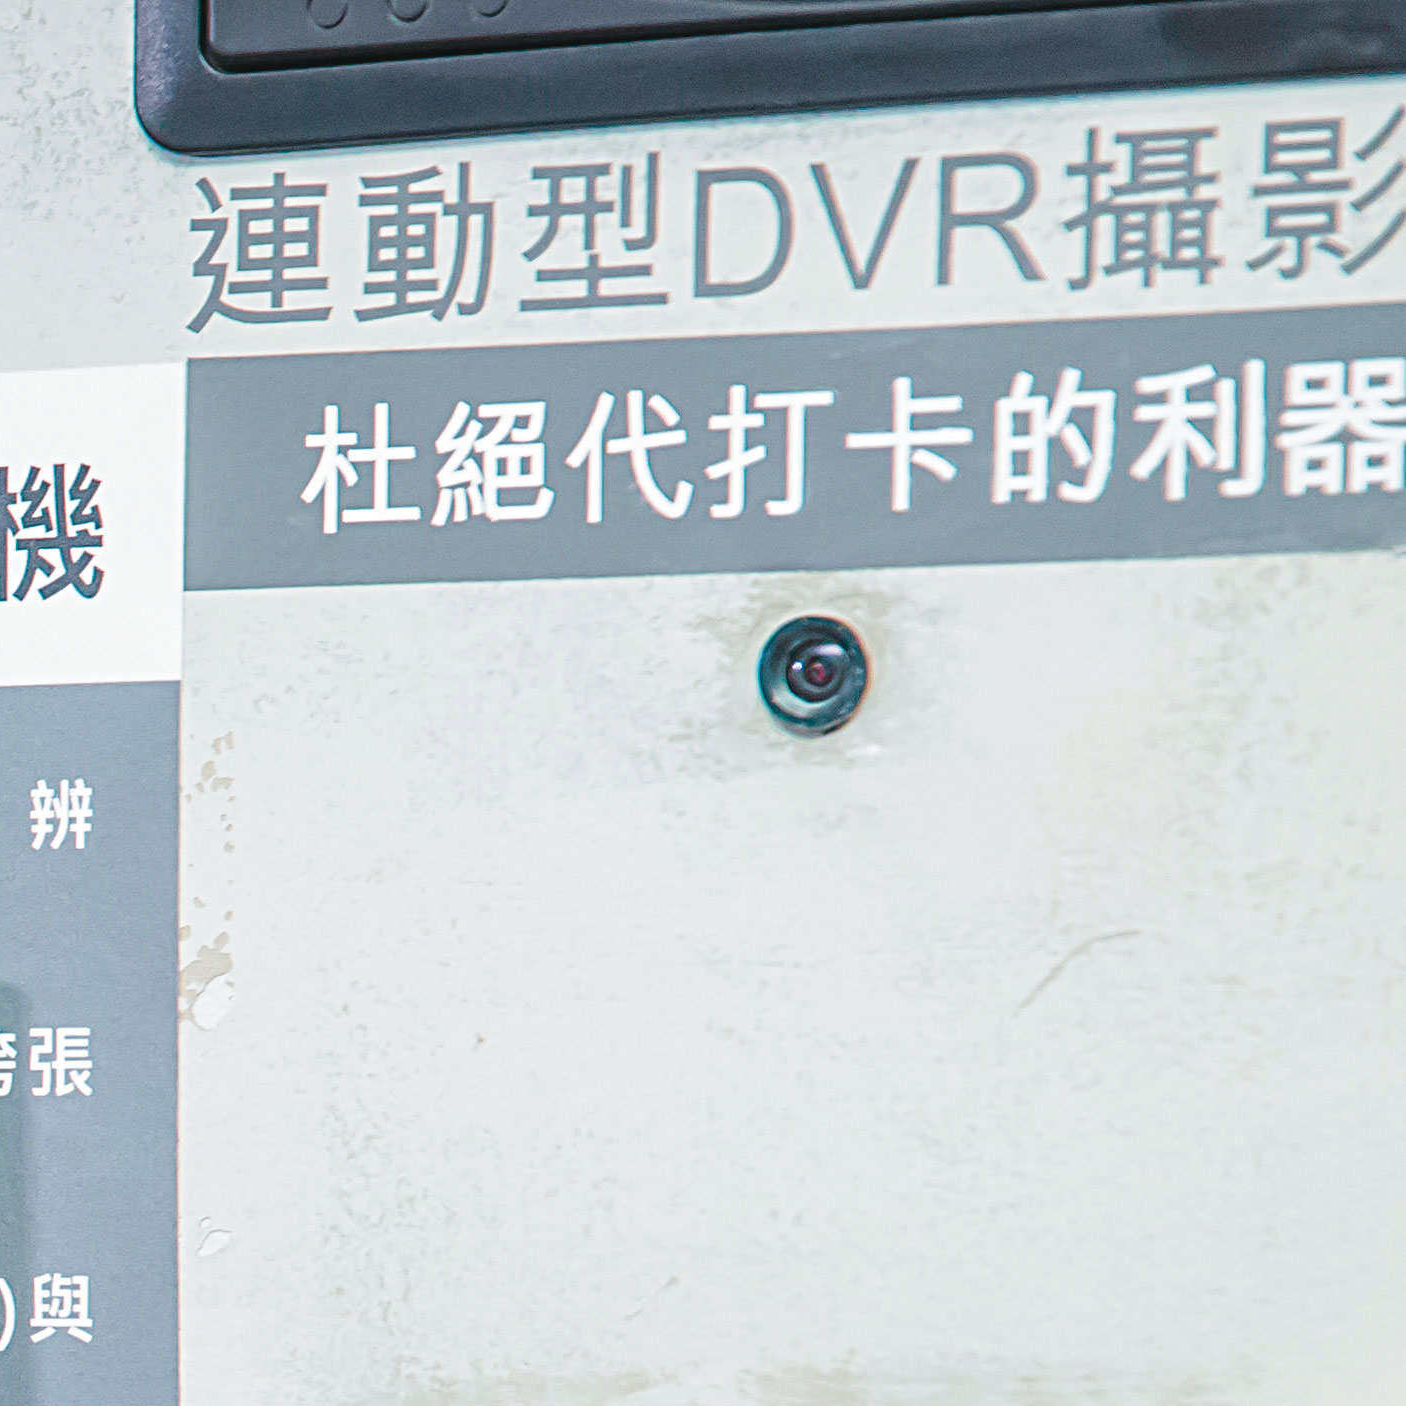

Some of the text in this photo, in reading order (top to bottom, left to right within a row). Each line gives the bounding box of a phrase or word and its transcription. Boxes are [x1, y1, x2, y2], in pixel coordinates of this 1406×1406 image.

[187, 103, 1406, 334] 連動型DVR攝影
[300, 356, 1406, 535] 杜絕代打卡的利器
